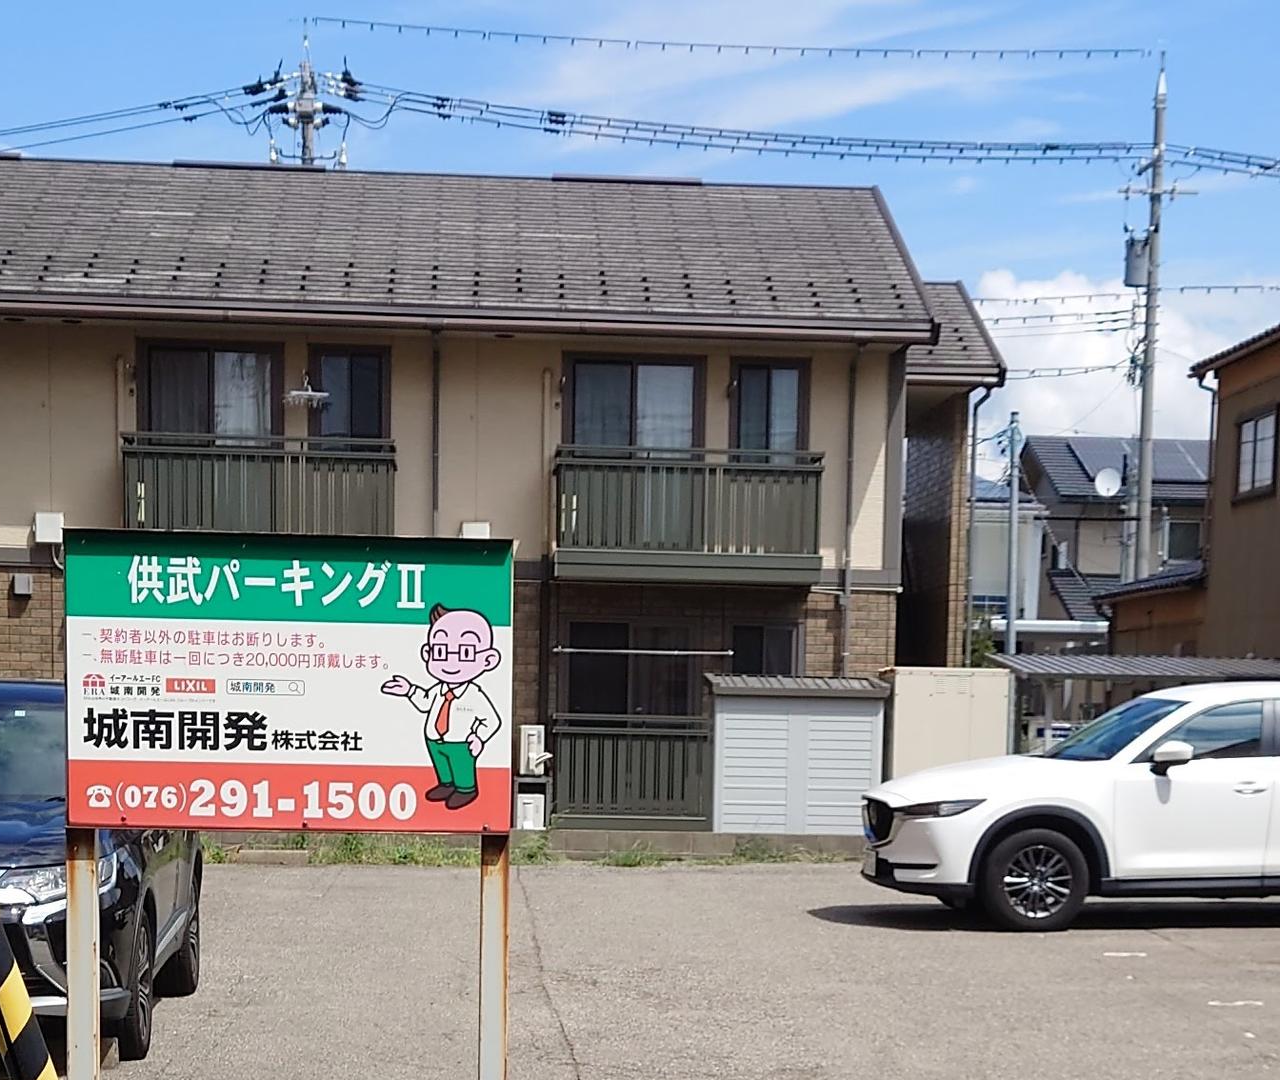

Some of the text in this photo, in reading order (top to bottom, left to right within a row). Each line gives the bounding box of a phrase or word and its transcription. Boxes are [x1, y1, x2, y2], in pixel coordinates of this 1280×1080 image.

[110, 686, 161, 696] 城南開発
[173, 680, 208, 692] LIXIL
[230, 681, 276, 693] 城南開発
[83, 688, 106, 696] ERA
